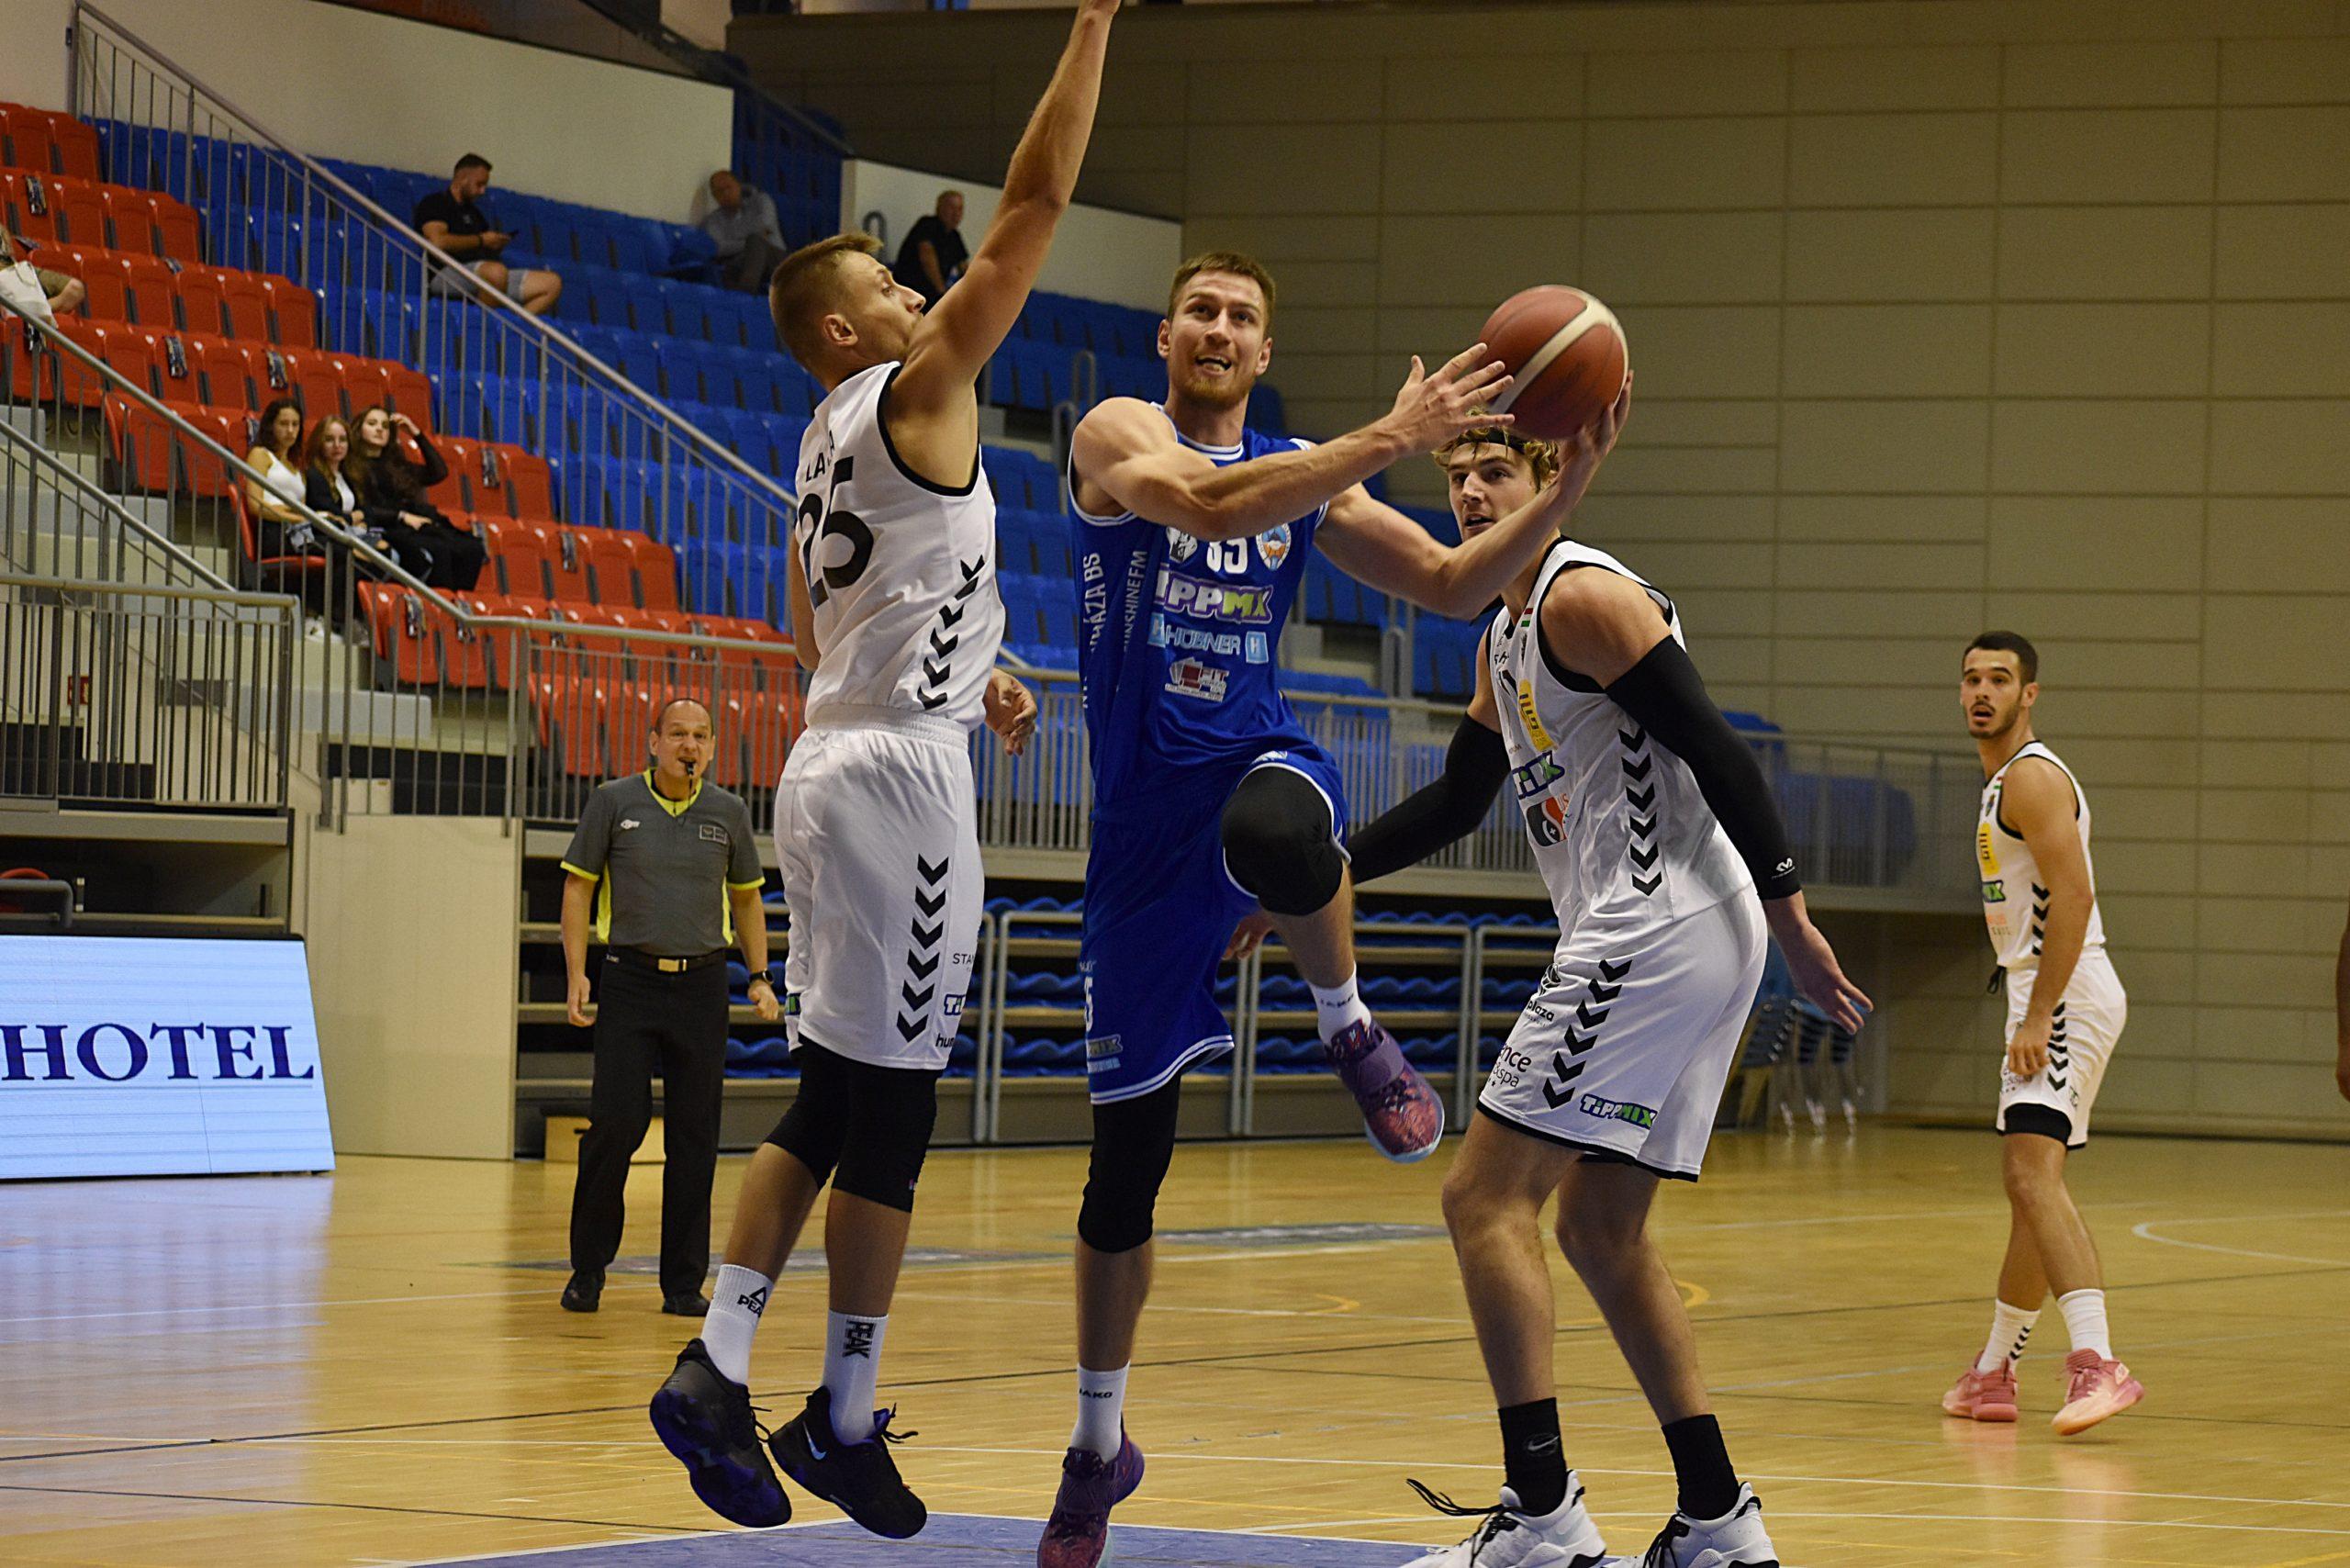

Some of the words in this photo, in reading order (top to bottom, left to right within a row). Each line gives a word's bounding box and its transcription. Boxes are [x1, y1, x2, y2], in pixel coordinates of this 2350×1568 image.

[799, 455, 874, 610] 25
[1082, 552, 1104, 582] BS
[1526, 1000, 1555, 1023] plaza
[0, 1022, 315, 1081] HOTEL
